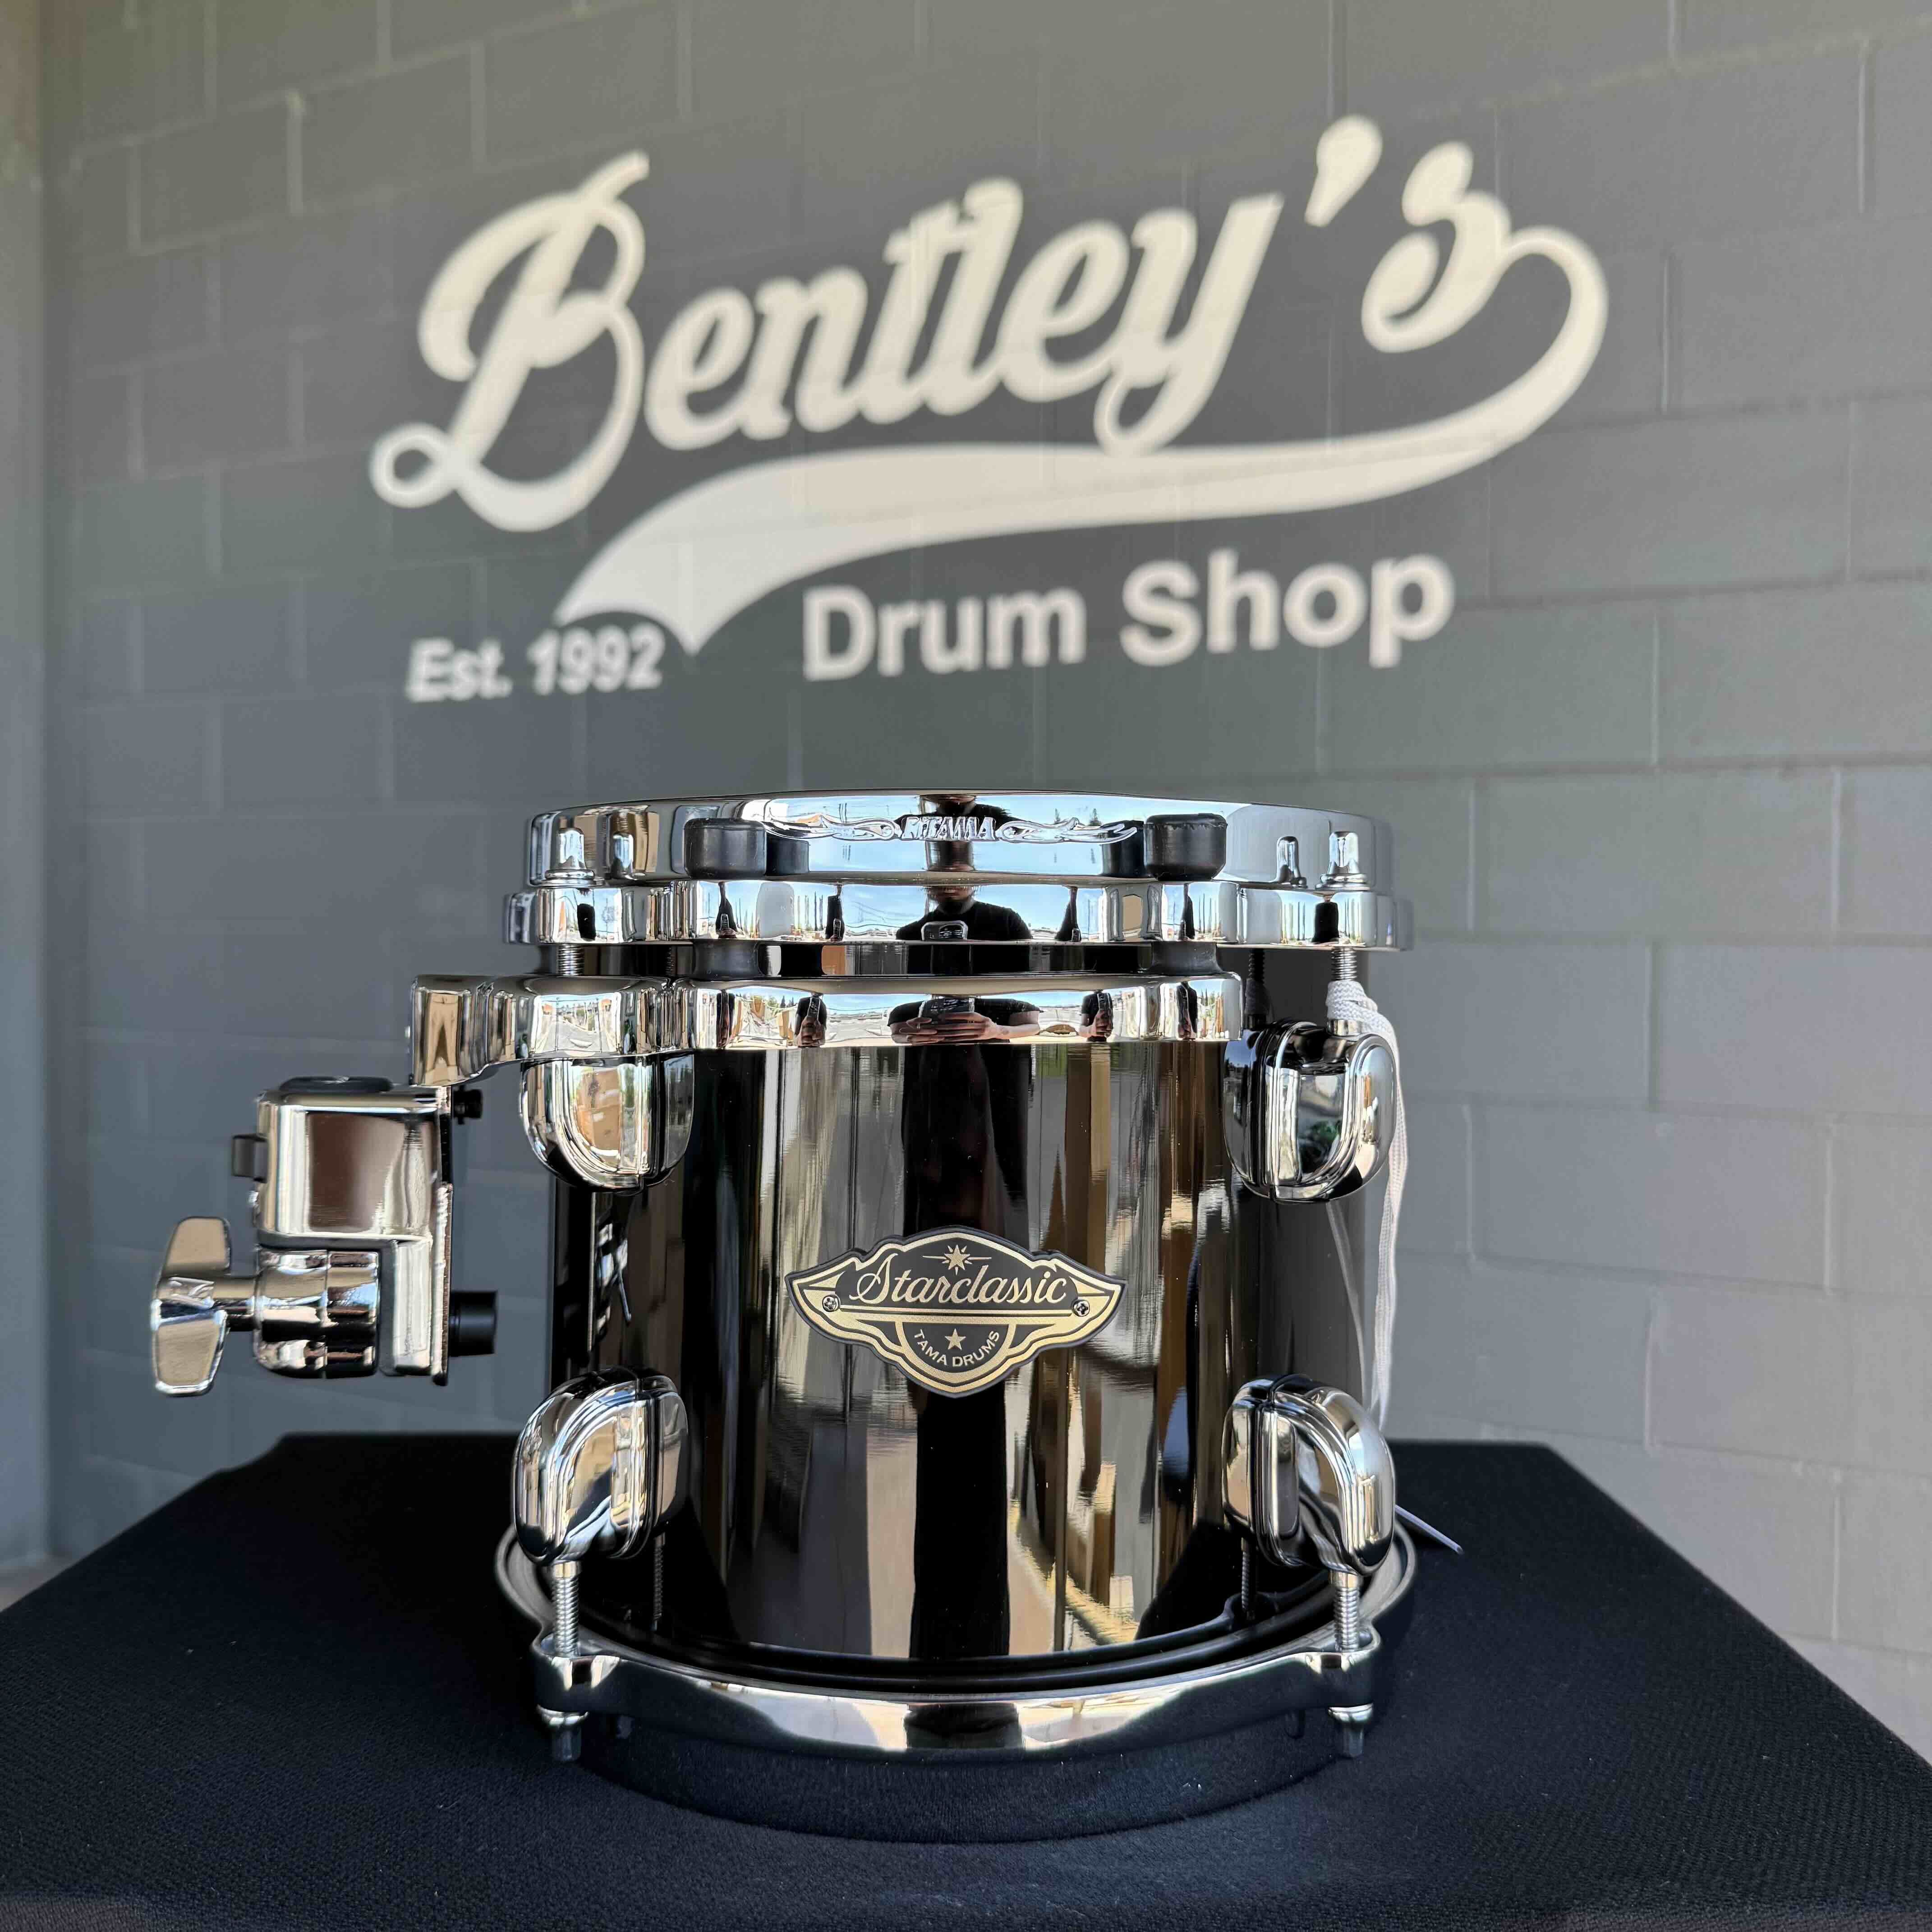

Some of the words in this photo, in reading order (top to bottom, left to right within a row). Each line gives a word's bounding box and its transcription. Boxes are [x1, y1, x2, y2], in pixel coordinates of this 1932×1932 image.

[370, 114, 1609, 532] Bentley's
[803, 584, 1088, 683] Drum
[1119, 547, 1457, 668] Shop
[407, 636, 513, 702] Est.
[527, 622, 666, 696] 1992
[849, 1252, 1067, 1304] Starclassic
[914, 1329, 948, 1366] TAMA
[952, 1331, 1000, 1367] DRUMS
